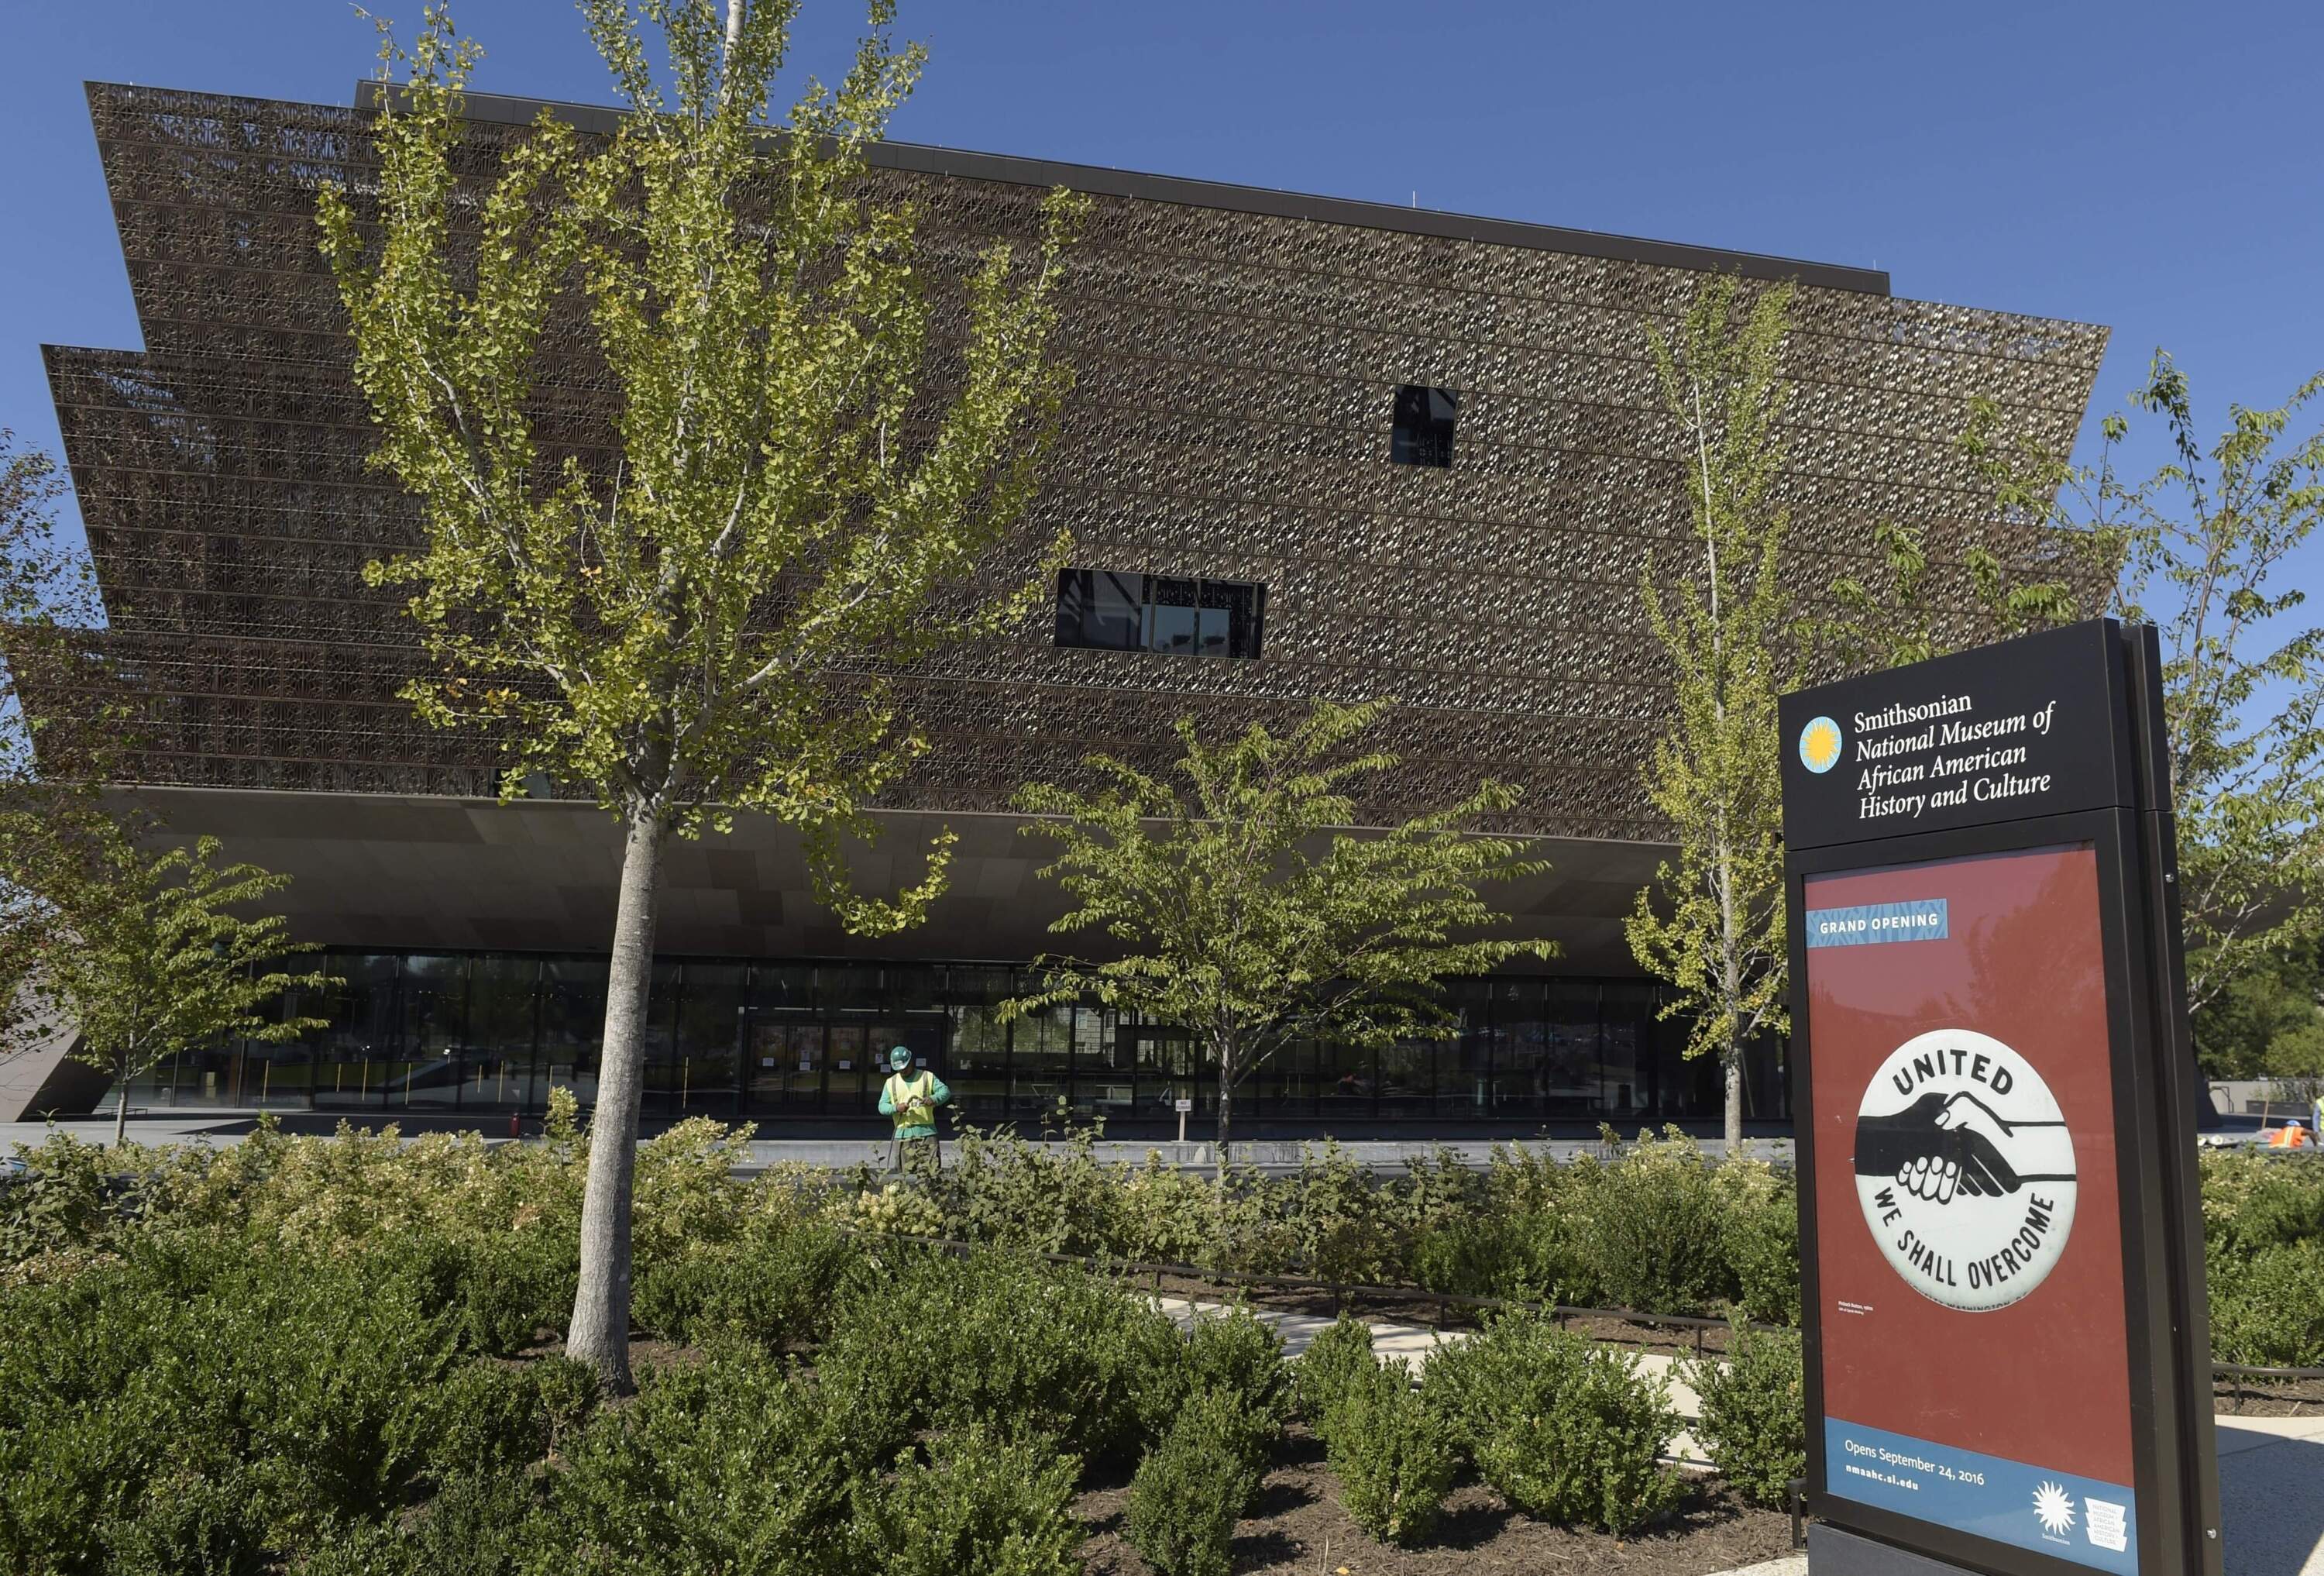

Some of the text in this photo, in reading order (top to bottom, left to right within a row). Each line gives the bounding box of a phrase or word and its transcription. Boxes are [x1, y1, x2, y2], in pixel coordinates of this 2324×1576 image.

[1855, 694, 1972, 734] Smithsonian
[1856, 700, 2057, 762] National Museum of
[1857, 745, 2027, 796] African American
[1859, 773, 2051, 819] History and Culture
[1820, 913, 1938, 934] GRAND OPENING
[1893, 1049, 2014, 1096] UNITED
[1875, 1186, 2054, 1289] WE SHALL OVERCOME
[1845, 1440, 1985, 1485] Opens September 24, 2016
